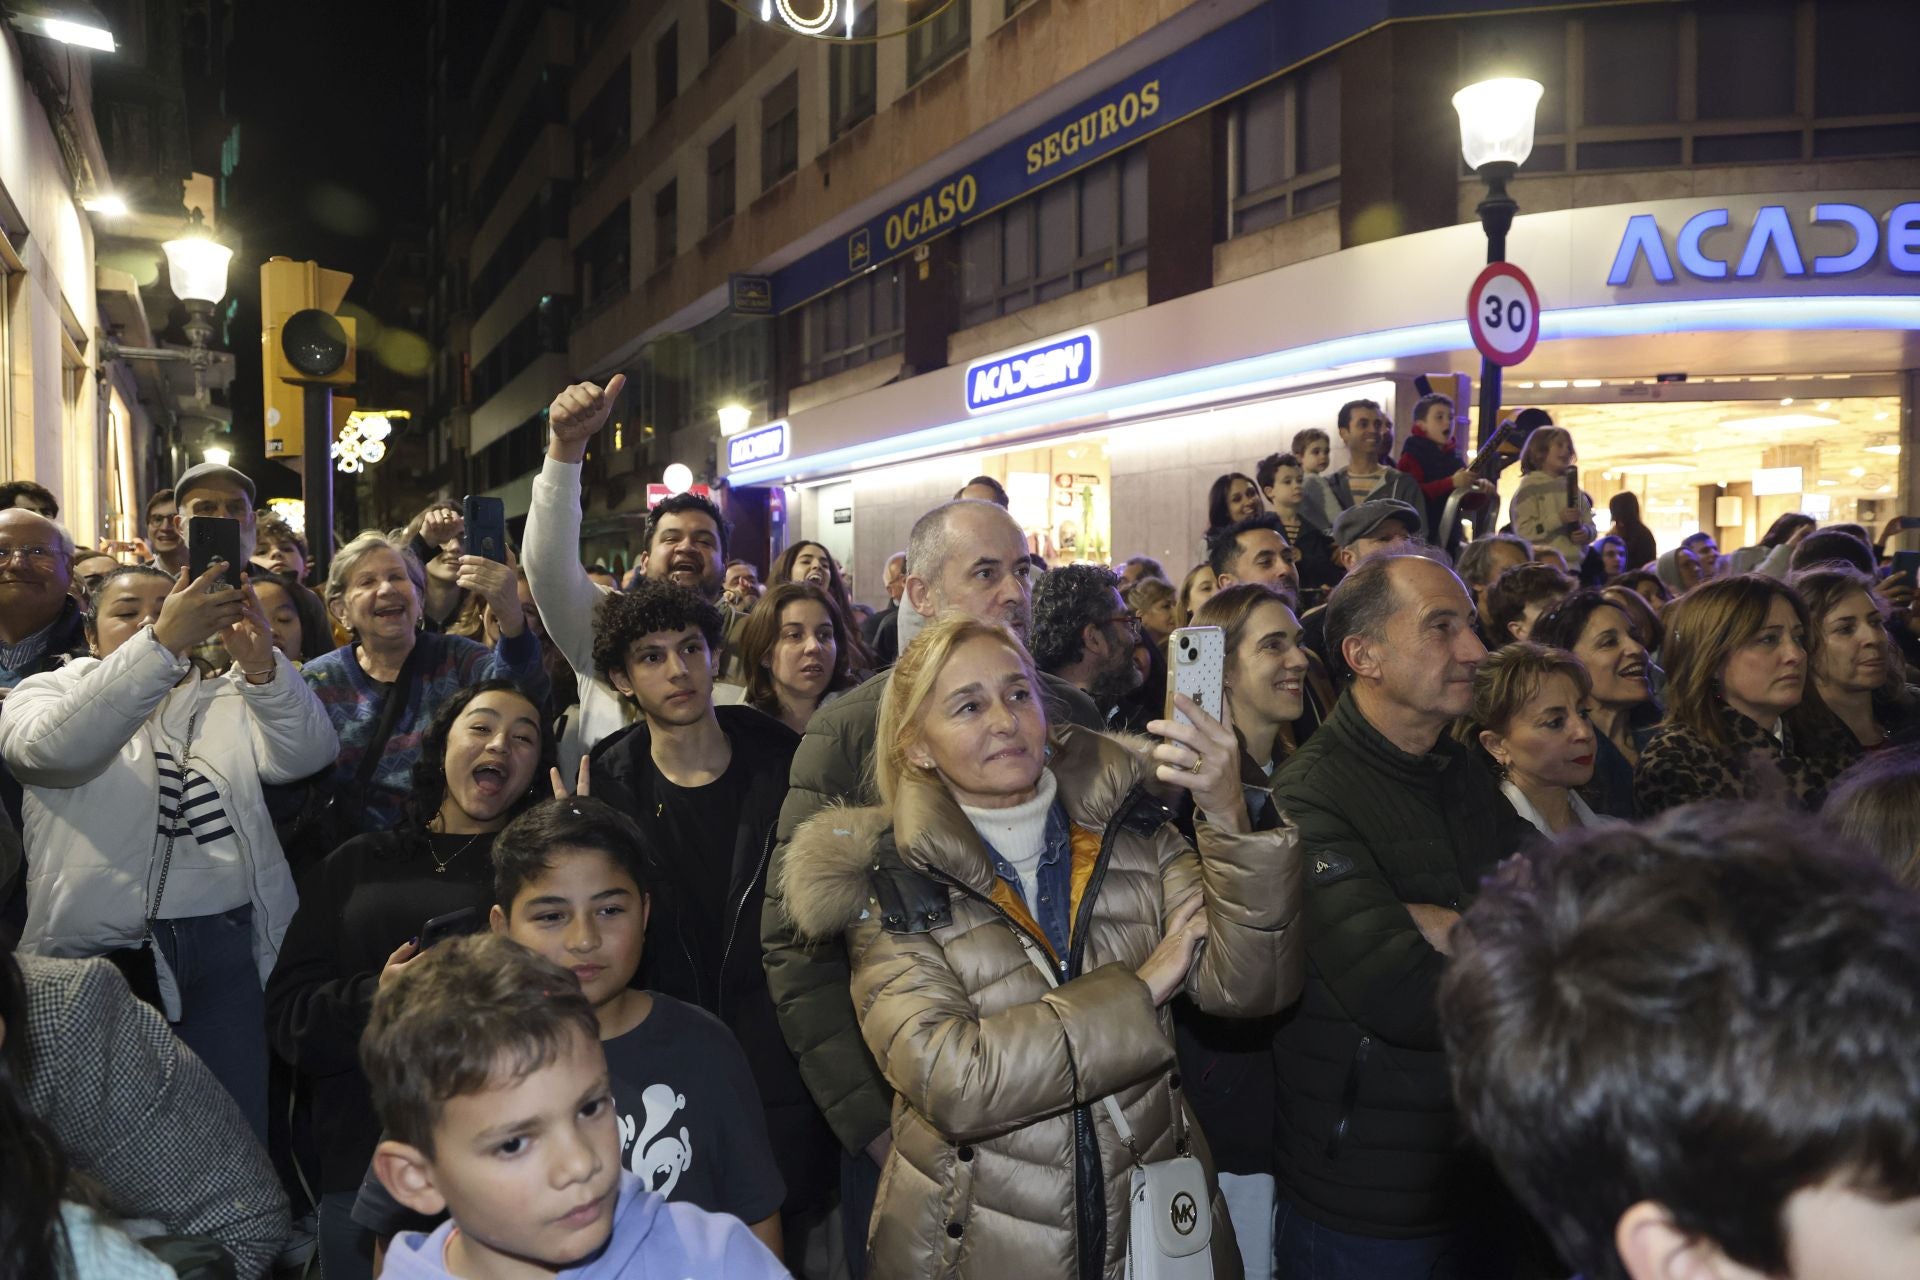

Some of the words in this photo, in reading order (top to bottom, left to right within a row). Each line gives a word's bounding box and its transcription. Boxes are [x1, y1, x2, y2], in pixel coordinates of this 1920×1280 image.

[885, 174, 977, 249] OCASO
[1026, 80, 1160, 175] SEGUROS
[1485, 295, 1526, 333] 30
[1173, 1203, 1194, 1223] MK
